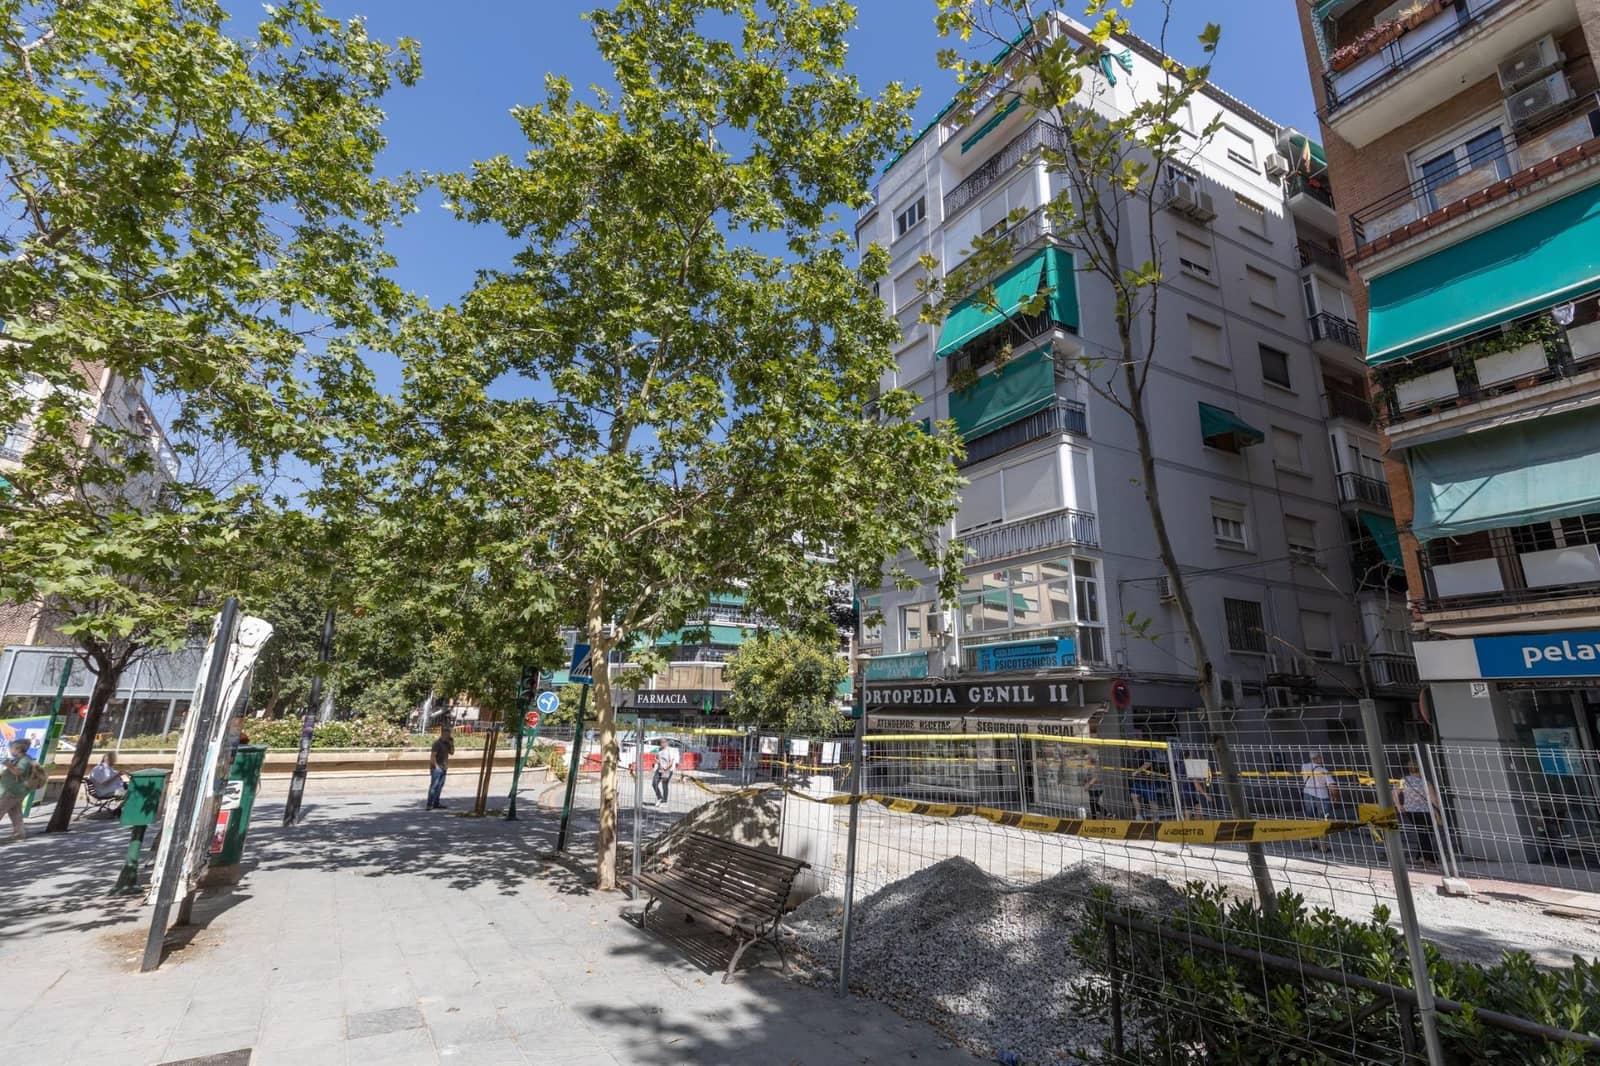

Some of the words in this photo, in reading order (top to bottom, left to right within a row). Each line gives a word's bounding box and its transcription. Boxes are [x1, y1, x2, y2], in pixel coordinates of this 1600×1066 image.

[637, 694, 688, 704] FARMACIA
[865, 688, 957, 704] ORTOPEDIA
[968, 685, 1035, 703] GENIL
[1048, 684, 1069, 702] II
[877, 719, 914, 729] ATENDEMOS
[919, 720, 952, 729] RECETAS
[976, 720, 1029, 734] SEGURIDAD
[1037, 724, 1075, 737] SOCIAL
